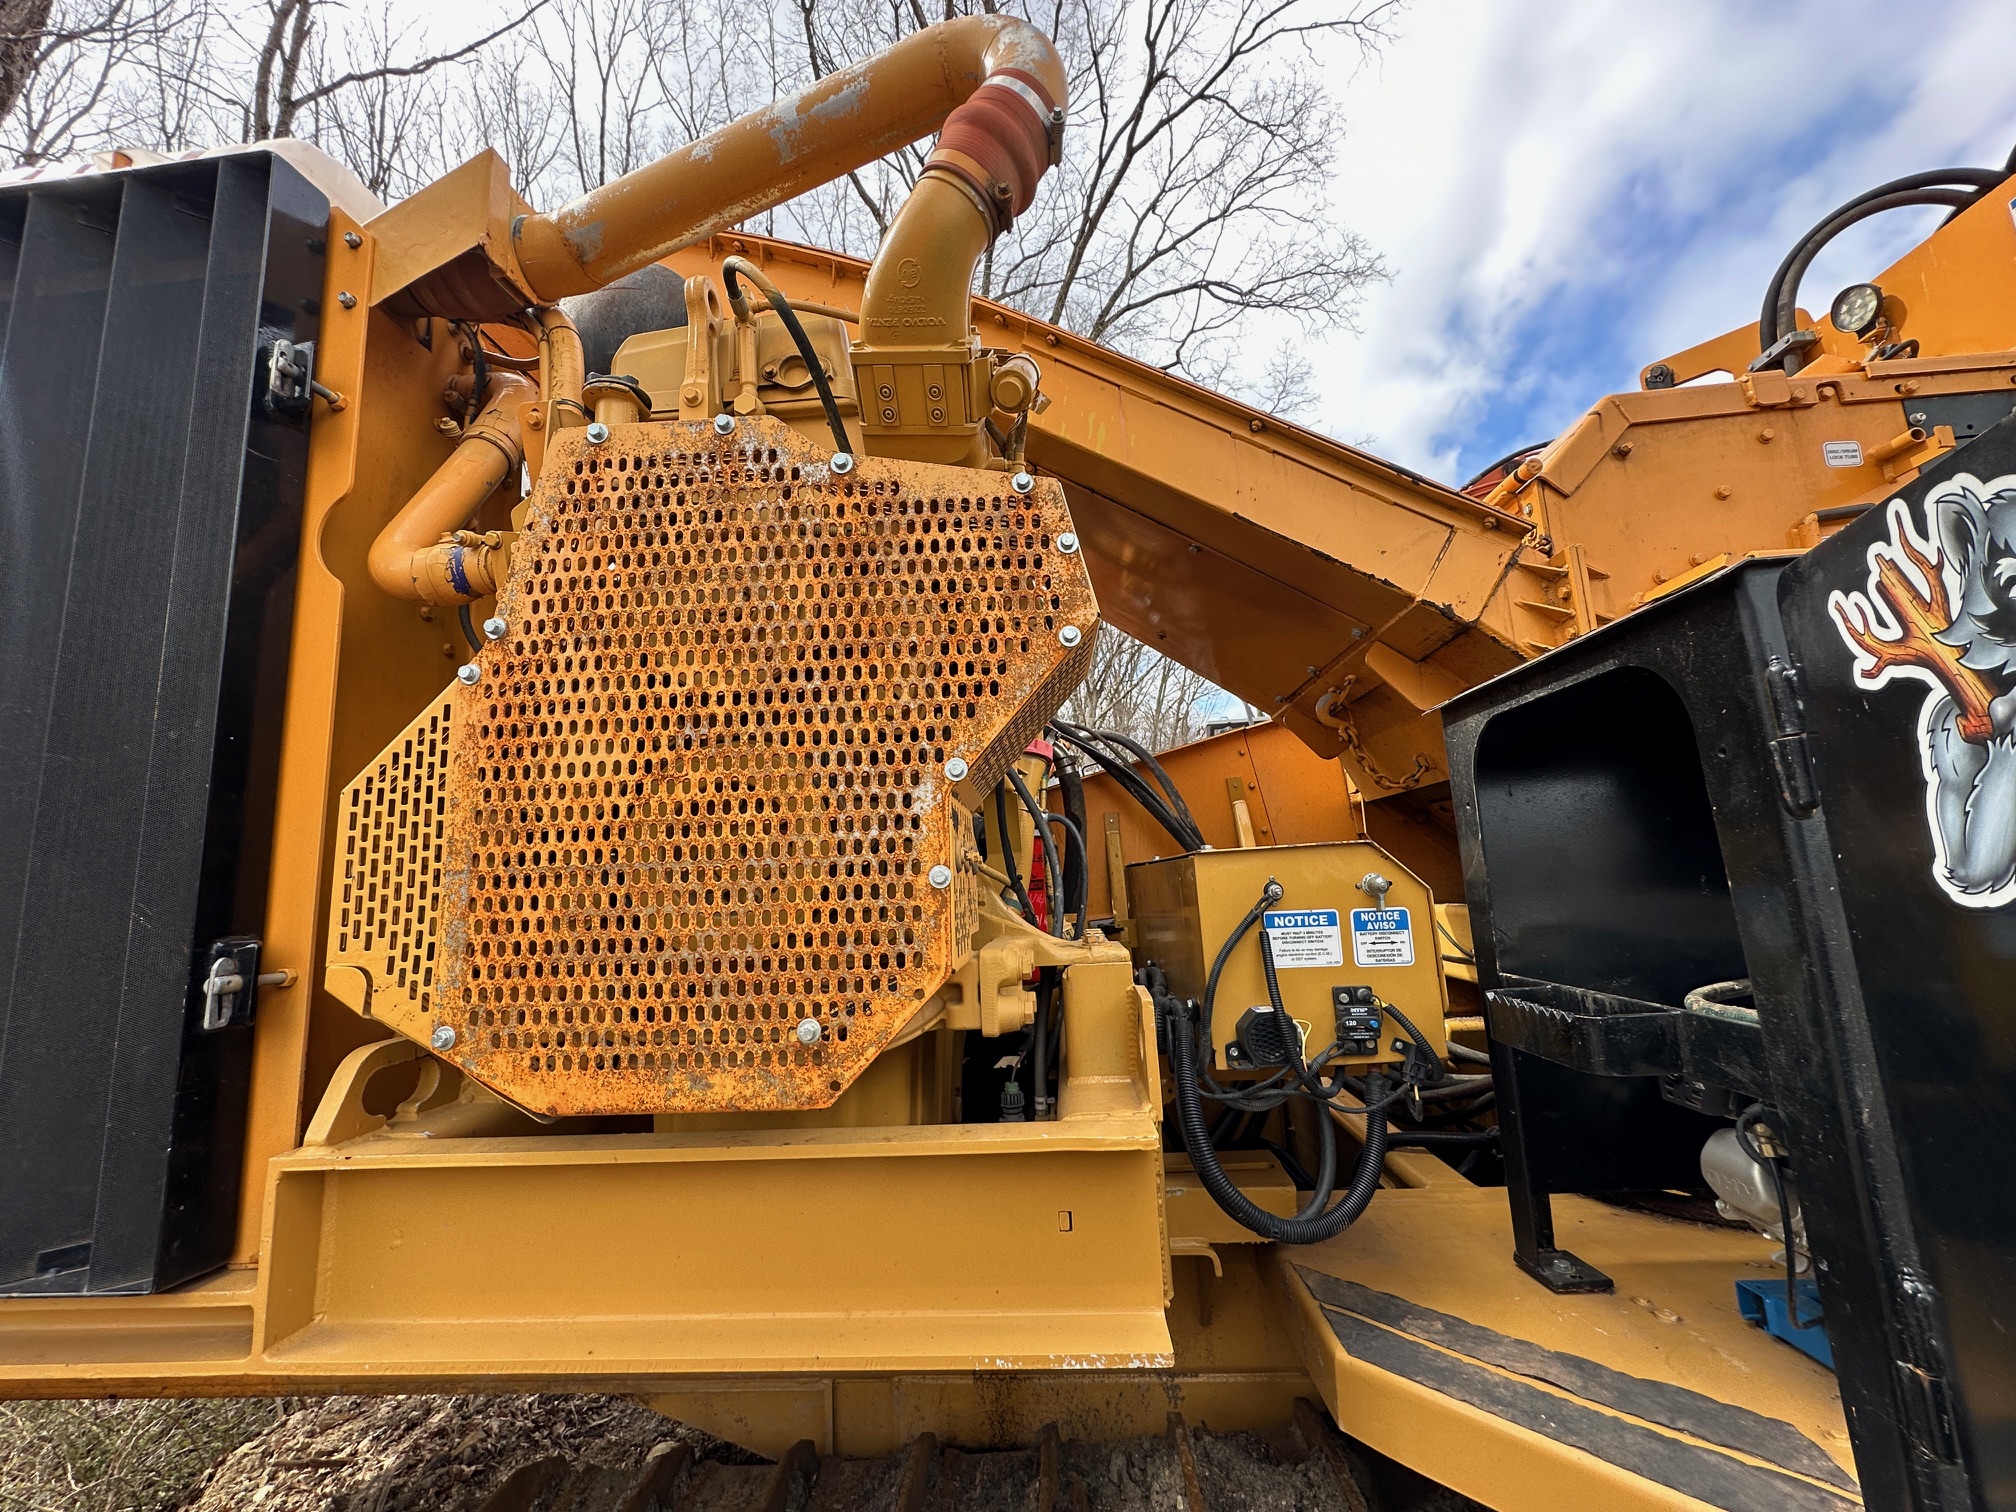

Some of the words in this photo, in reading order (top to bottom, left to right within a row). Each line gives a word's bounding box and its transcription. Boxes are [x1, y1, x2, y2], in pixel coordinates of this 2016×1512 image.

[866, 317, 900, 328] PENTA
[902, 316, 946, 328] VOLVO
[1274, 915, 1328, 927] NOTICE
[1360, 911, 1400, 921] NOTICE
[1367, 921, 1396, 930] AVISO
